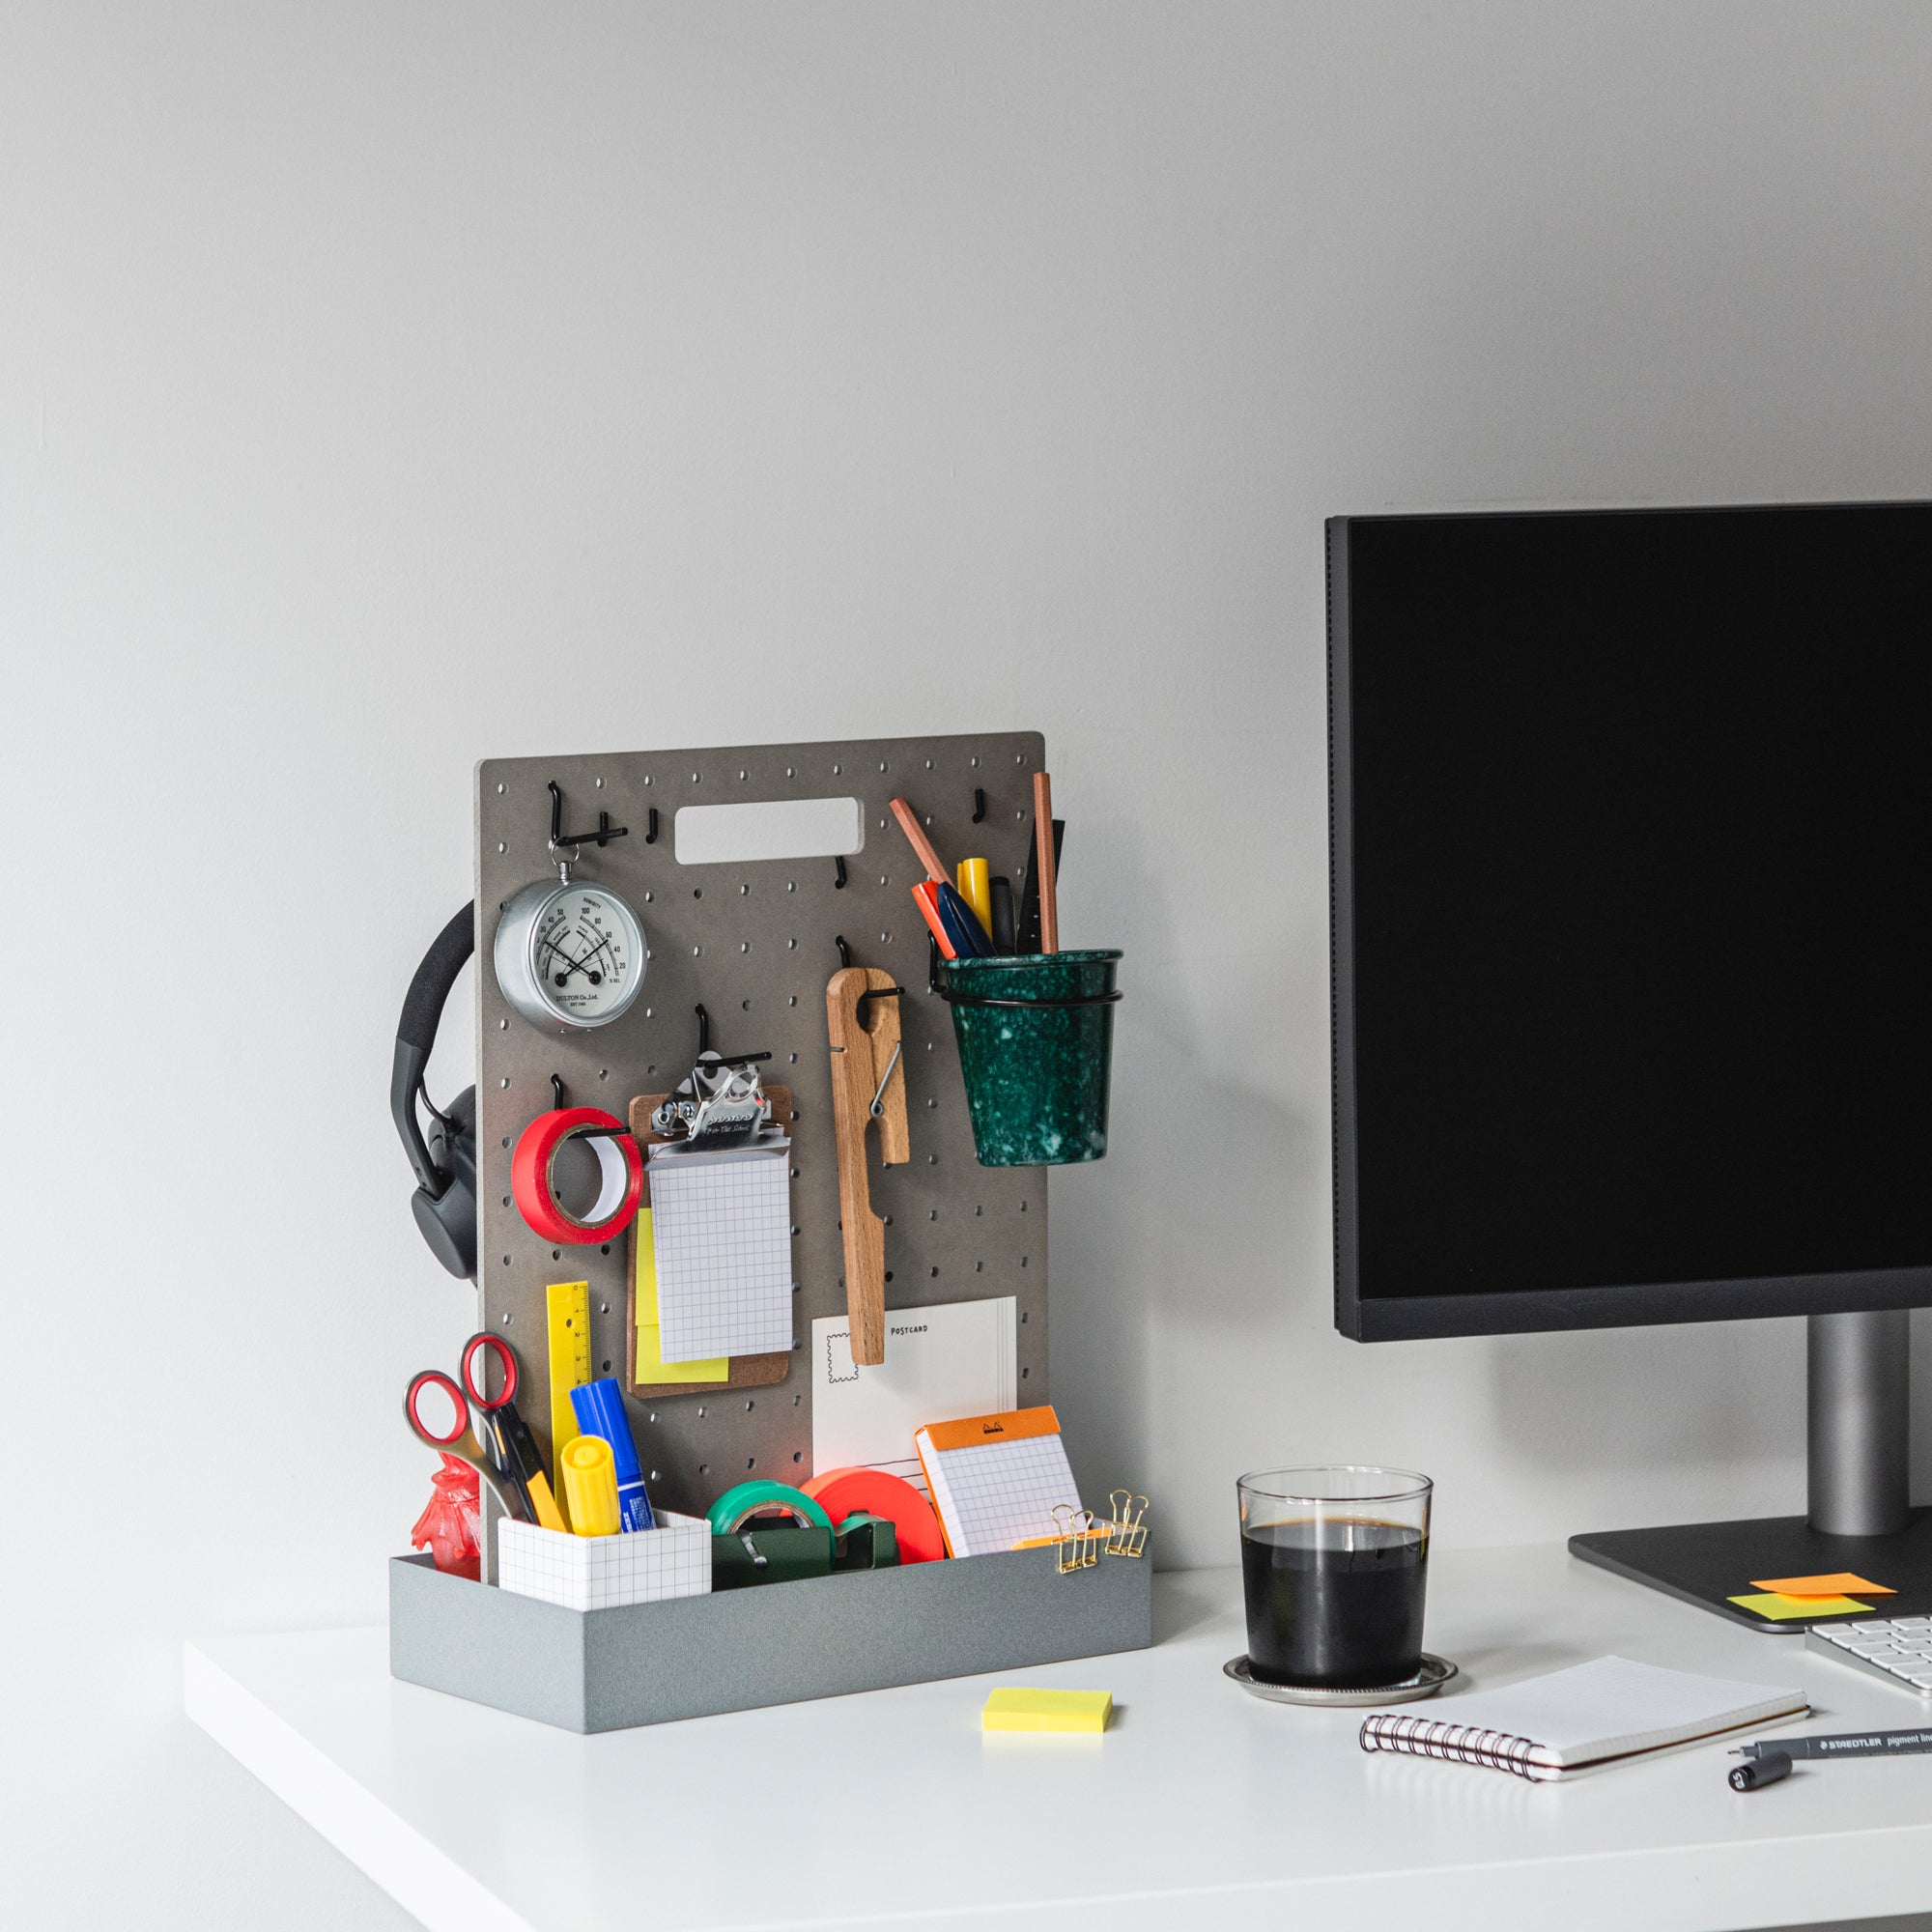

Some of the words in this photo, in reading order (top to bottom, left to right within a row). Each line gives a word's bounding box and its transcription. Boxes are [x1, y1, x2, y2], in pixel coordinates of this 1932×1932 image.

[583, 897, 601, 909] HUMIDITY
[891, 1325, 928, 1336] POSTCARD
[1829, 1738, 1882, 1749] STAEDTLER
[1887, 1735, 1919, 1747] pigment
